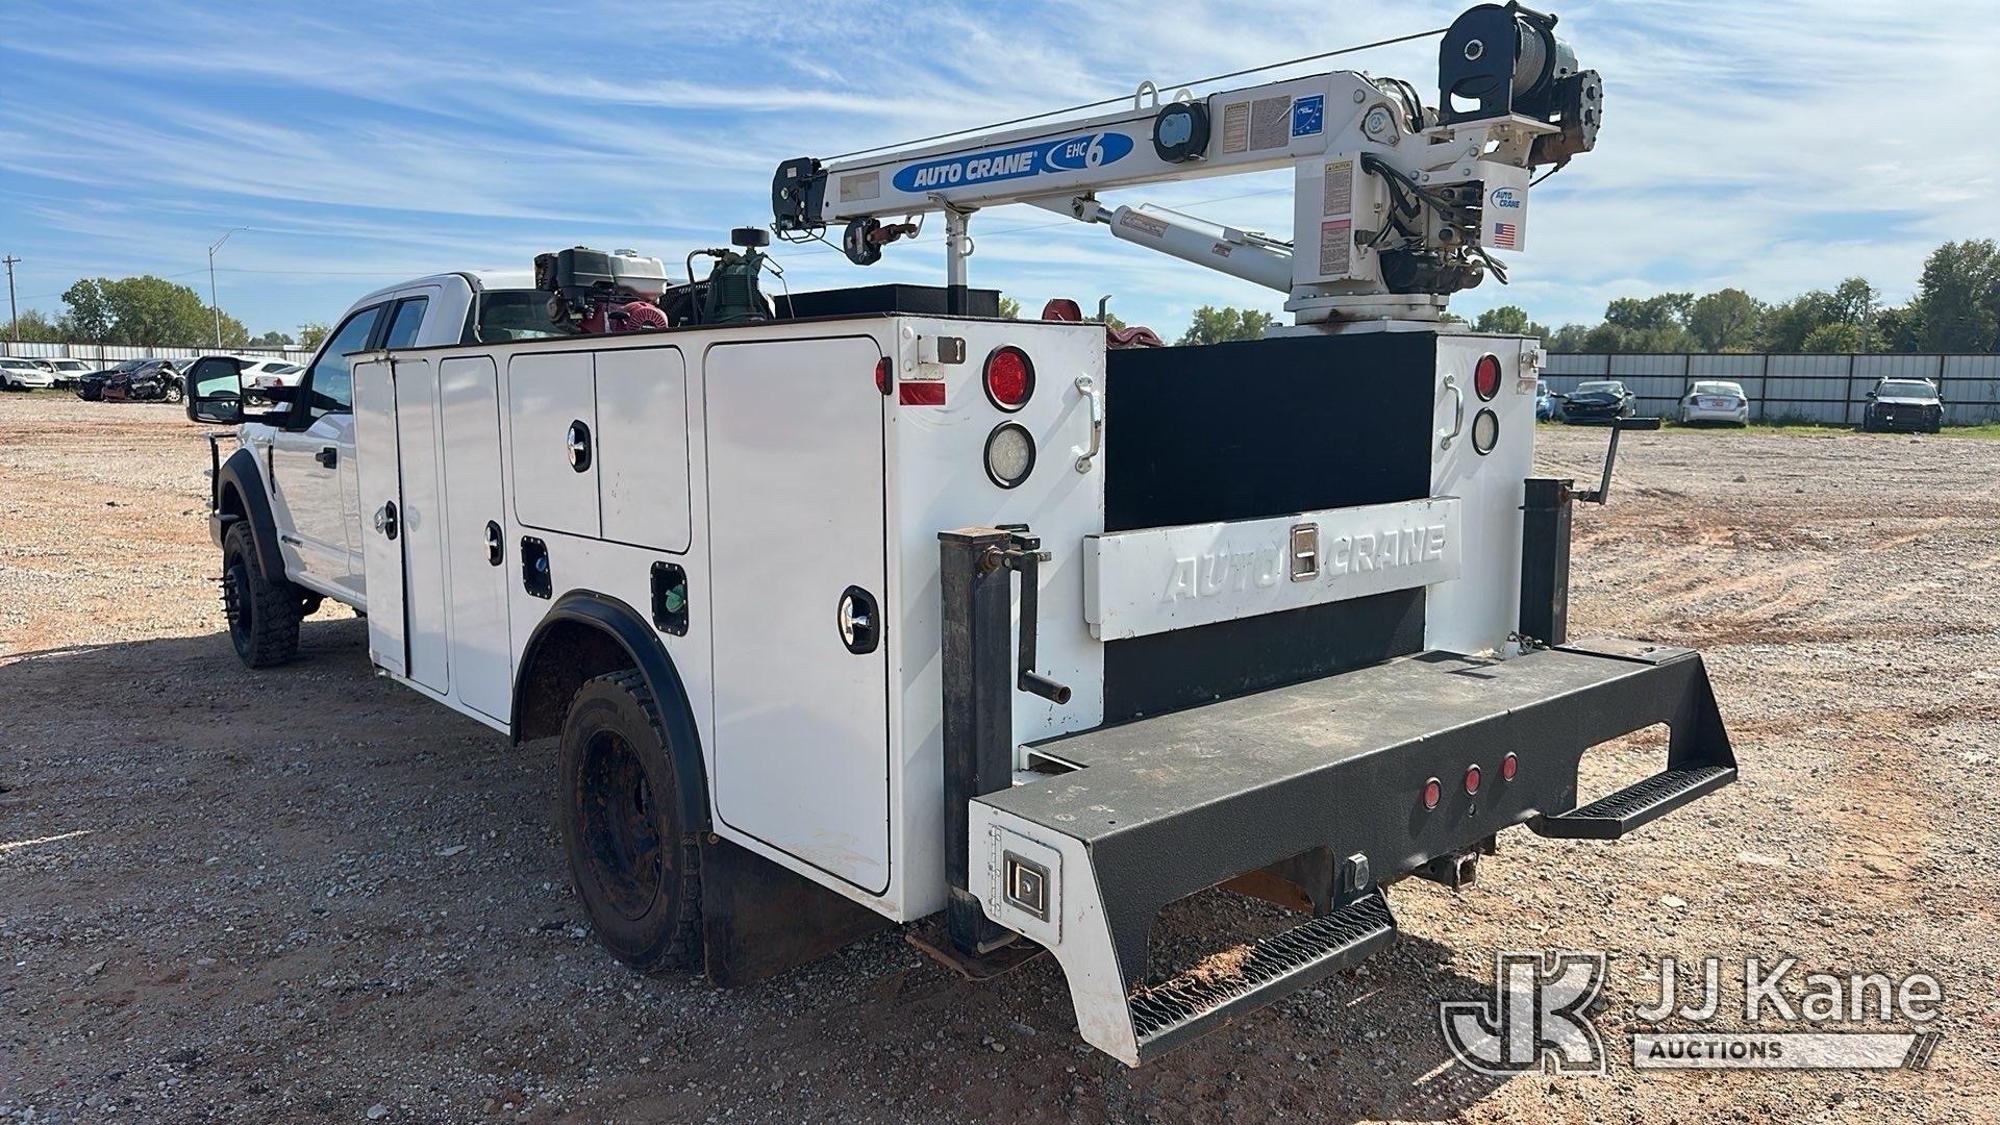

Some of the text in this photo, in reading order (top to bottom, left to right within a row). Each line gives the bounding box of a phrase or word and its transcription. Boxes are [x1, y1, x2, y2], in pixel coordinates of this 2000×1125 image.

[913, 151, 1032, 188] AUTO CRANE
[1495, 191, 1513, 200] AUTO
[1499, 199, 1520, 208] CRANE
[1161, 525, 1446, 602] AUTO CRANE
